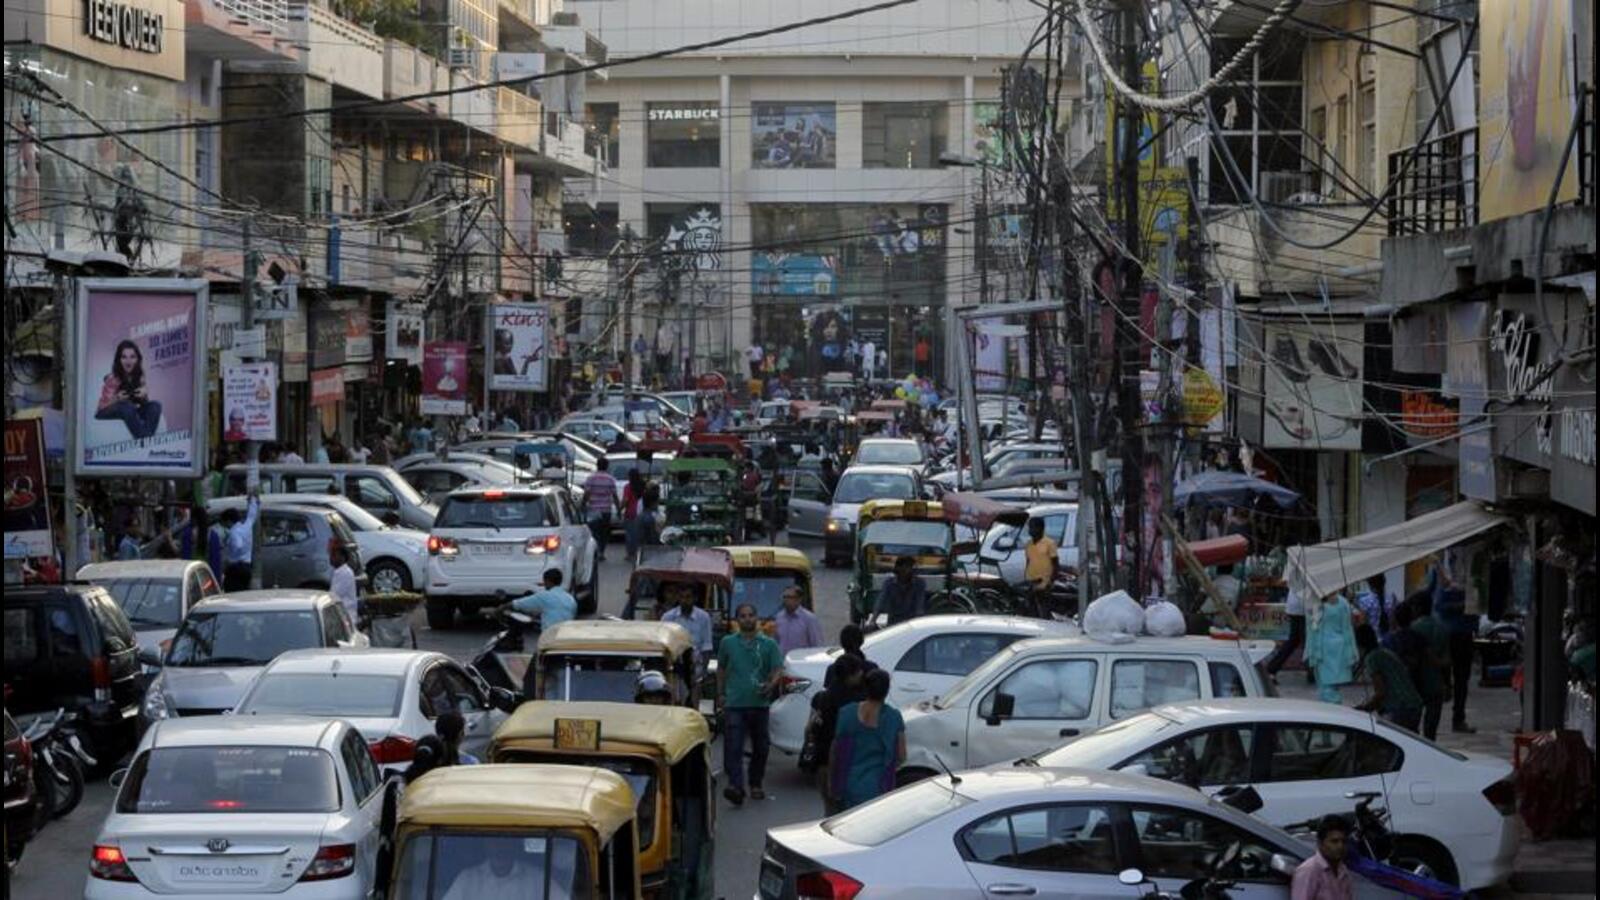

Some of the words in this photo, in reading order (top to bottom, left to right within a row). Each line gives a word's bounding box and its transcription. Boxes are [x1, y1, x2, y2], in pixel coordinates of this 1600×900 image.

[86, 0, 121, 44] TEEN
[122, 6, 163, 54] QUEEN
[648, 108, 719, 120] STARBUCK
